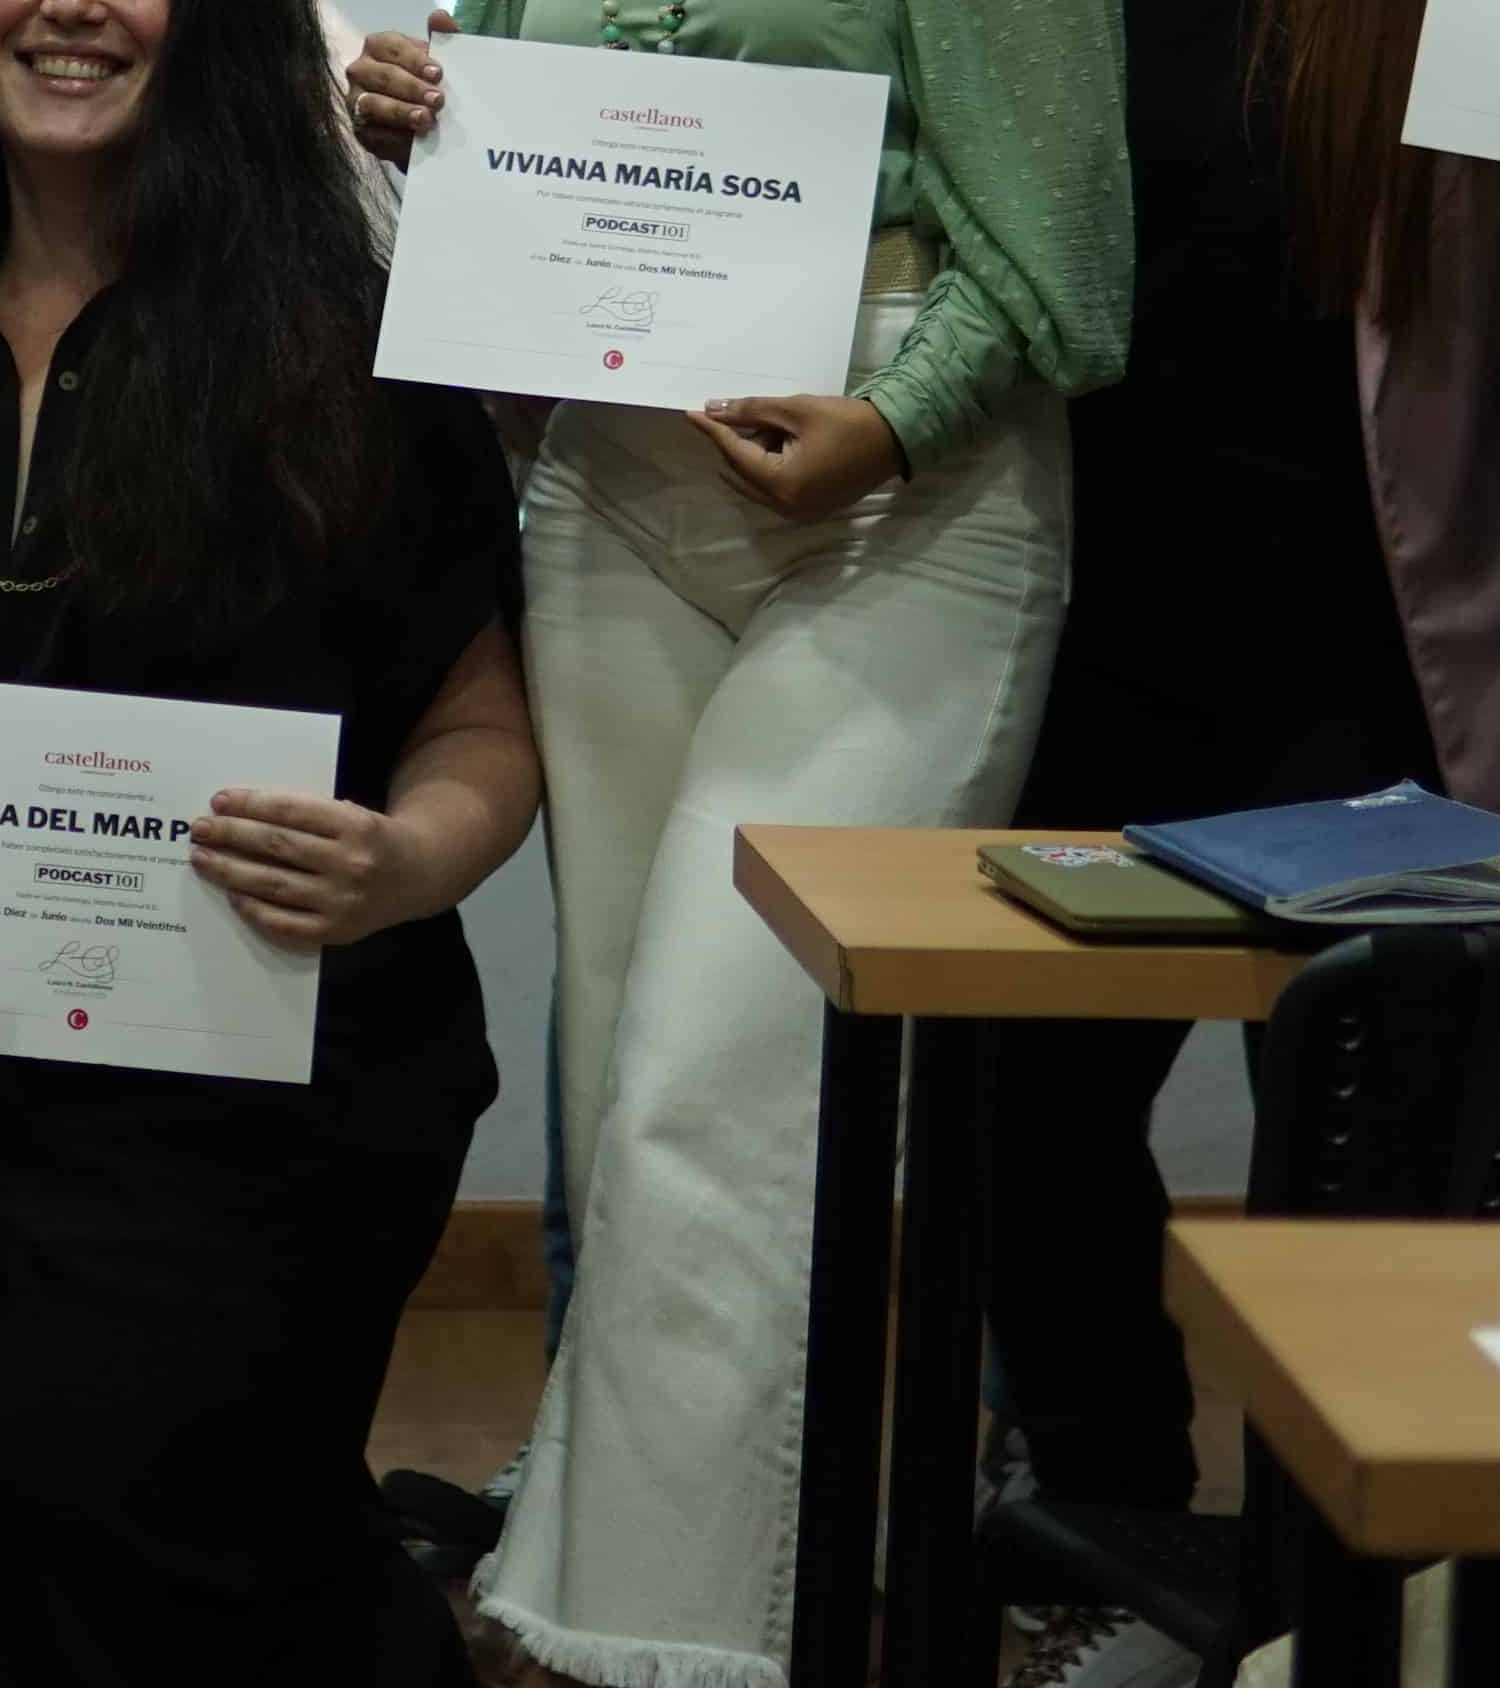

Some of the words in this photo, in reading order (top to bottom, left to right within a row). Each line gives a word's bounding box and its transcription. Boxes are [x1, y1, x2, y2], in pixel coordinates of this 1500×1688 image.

[599, 107, 704, 129] castellanos
[487, 148, 606, 183] VIVIANA
[615, 163, 713, 194] MARÍA
[721, 174, 802, 203] SOSA
[585, 217, 658, 235] PODCAST
[662, 225, 684, 238] 101
[44, 751, 152, 773] castellanos
[28, 806, 85, 833] DEL
[93, 812, 162, 840] MAR
[170, 820, 190, 842] P
[38, 867, 113, 885] PODCAST
[116, 874, 138, 889] 101
